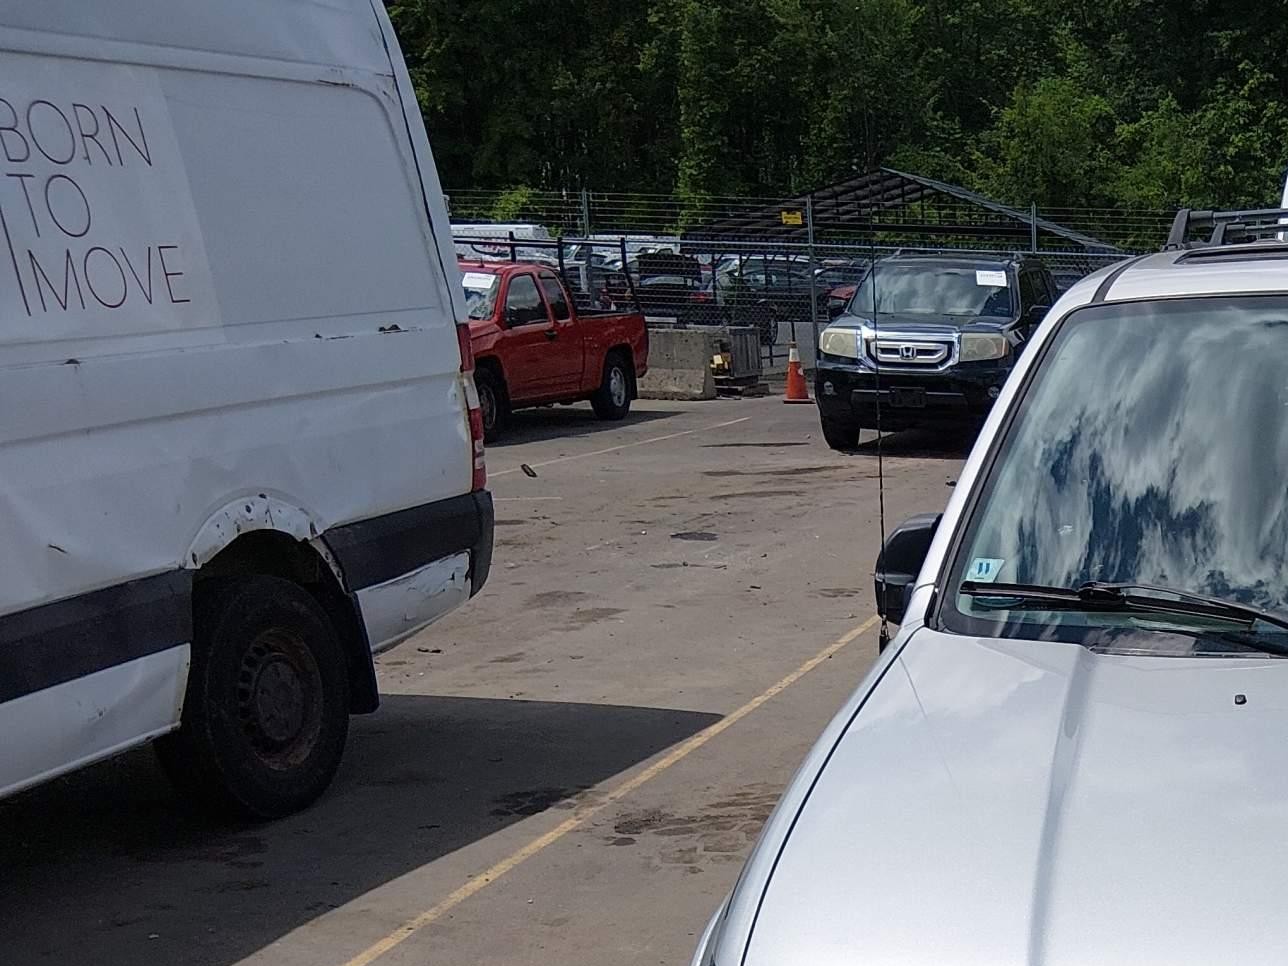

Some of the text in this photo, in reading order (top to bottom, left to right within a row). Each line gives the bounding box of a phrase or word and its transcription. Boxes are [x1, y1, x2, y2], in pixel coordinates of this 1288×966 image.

[0, 98, 152, 166] BORN
[6, 174, 91, 238] TO
[28, 246, 191, 312] MOVE
